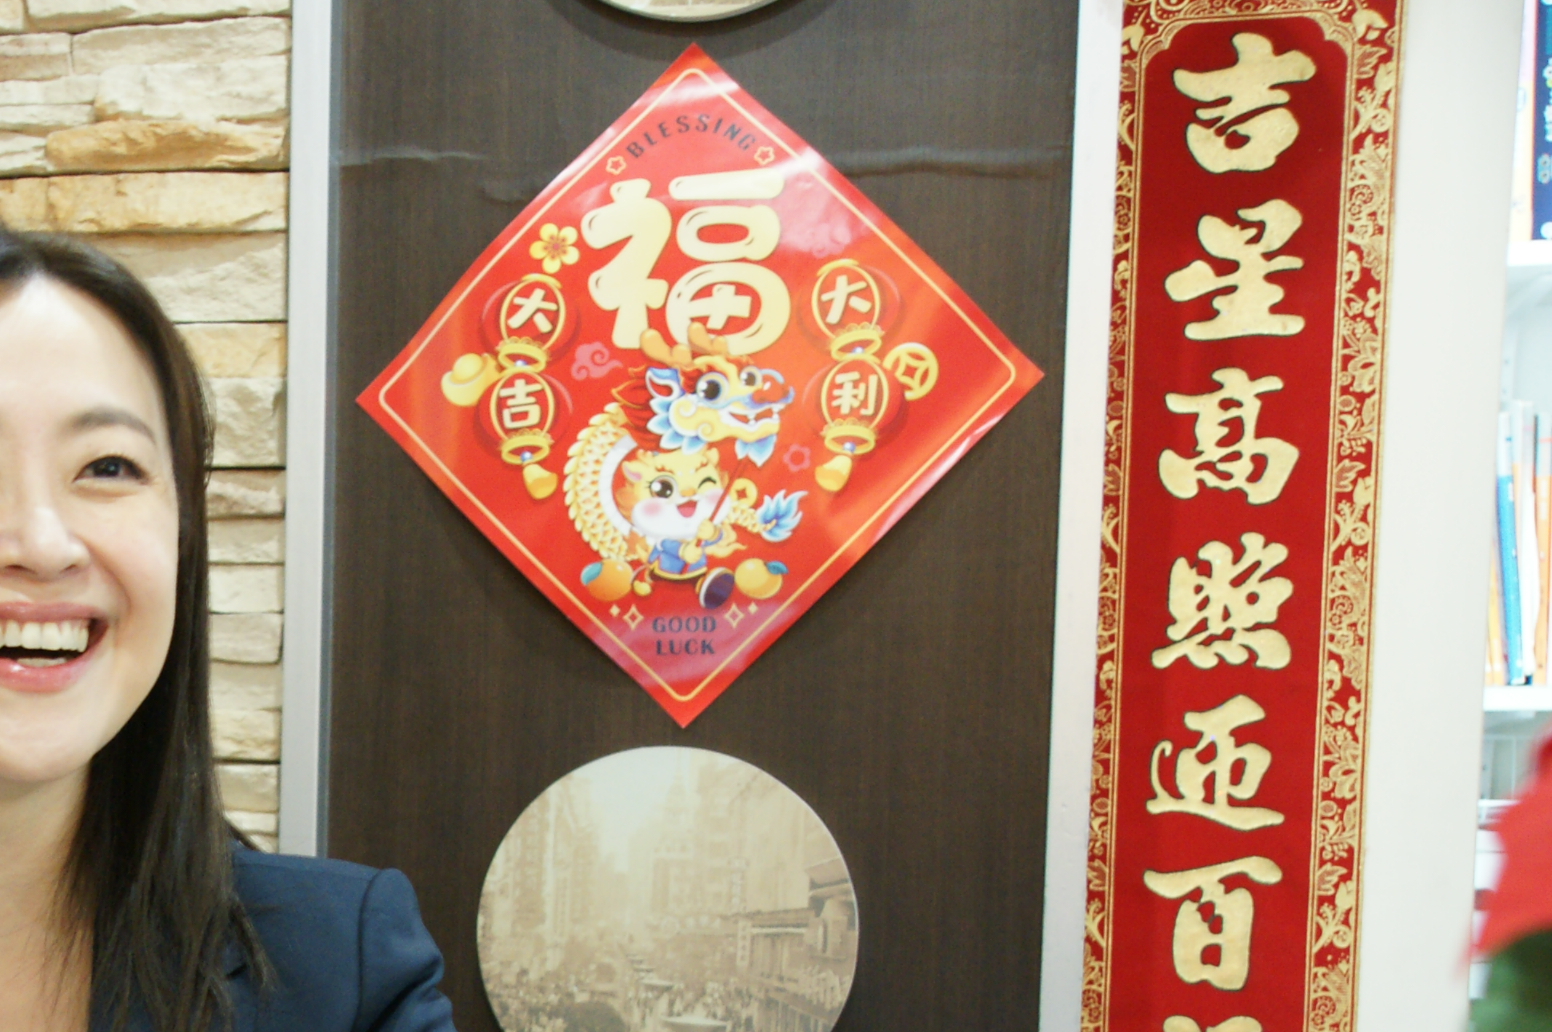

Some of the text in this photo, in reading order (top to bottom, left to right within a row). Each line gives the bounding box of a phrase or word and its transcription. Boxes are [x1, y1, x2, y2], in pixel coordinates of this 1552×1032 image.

[625, 113, 757, 159] BLESSING
[580, 167, 791, 355] 福
[652, 615, 716, 634] GOOD
[656, 637, 716, 656] LUCK
